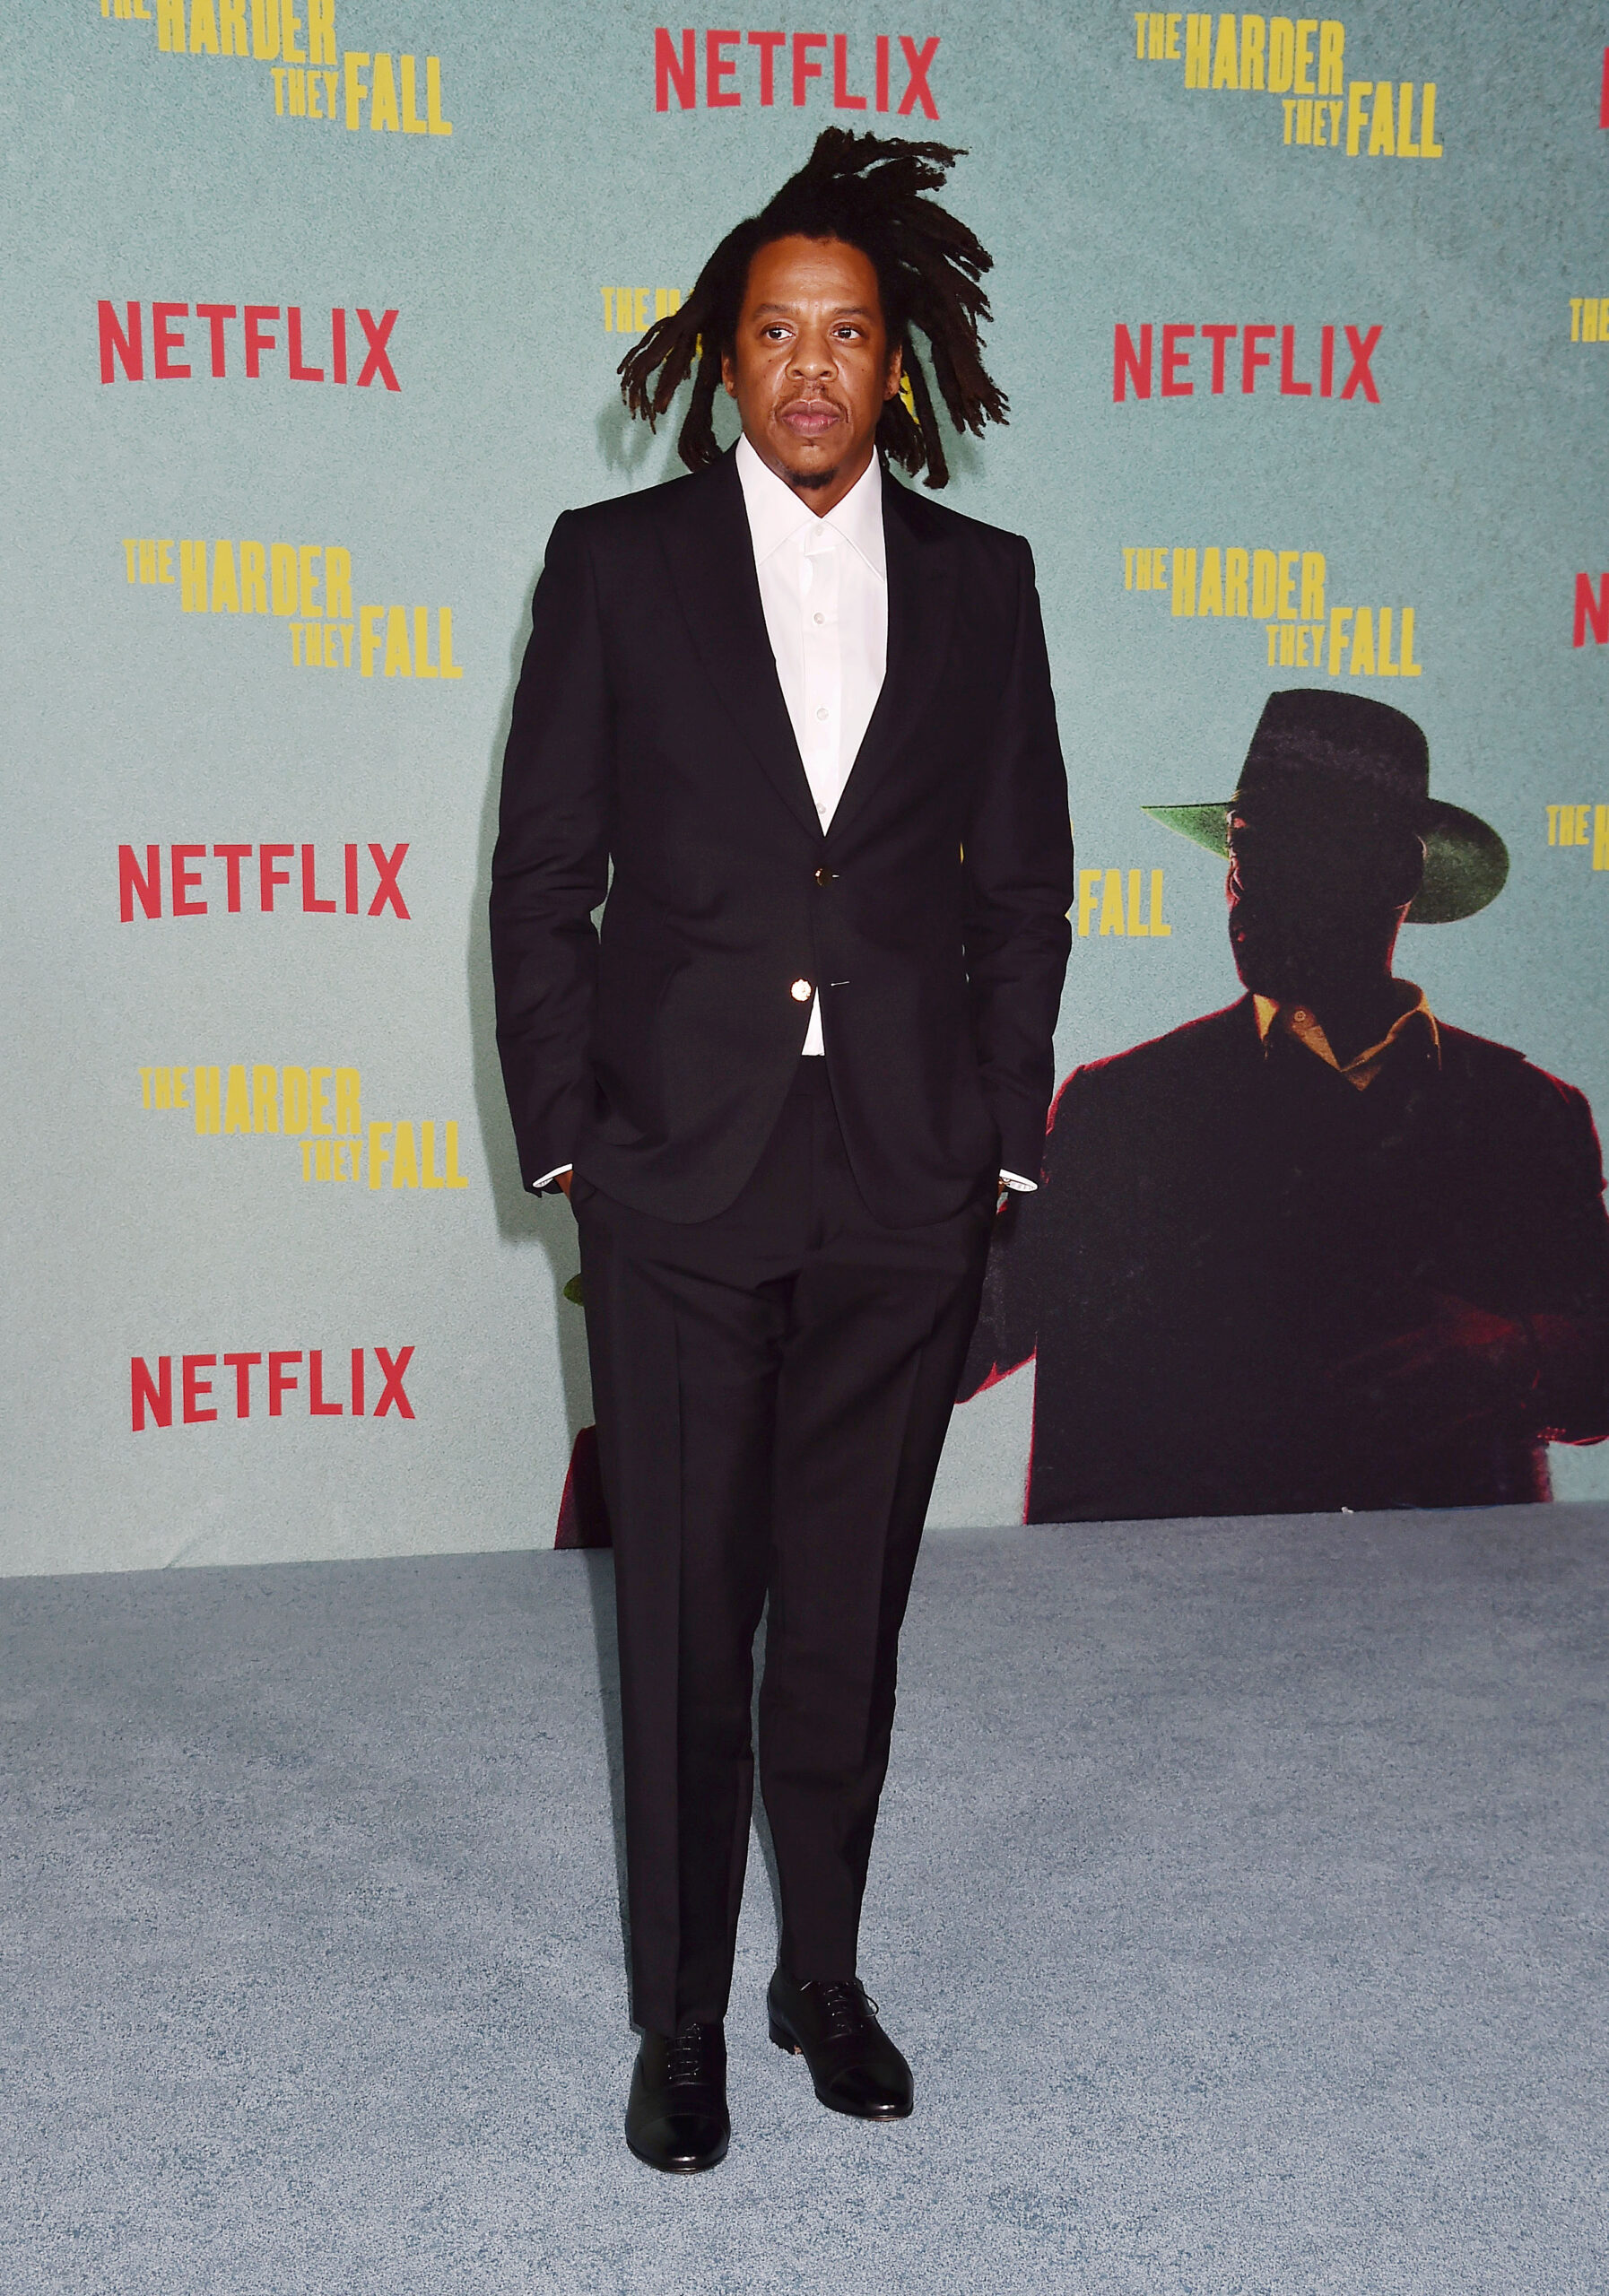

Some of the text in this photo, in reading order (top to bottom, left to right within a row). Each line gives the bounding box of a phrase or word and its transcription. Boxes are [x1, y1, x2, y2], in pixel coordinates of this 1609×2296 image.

[157, 0, 337, 65] HARDER
[1132, 13, 1345, 96] THE HARDER
[271, 51, 453, 135] THEY FALL
[656, 29, 940, 120] NETFLIX
[1283, 81, 1443, 159] THEY FALL
[98, 300, 401, 392] NETFLIX
[601, 287, 650, 333] THE
[1113, 324, 1383, 404] NETFLIX
[123, 540, 353, 619] THE HARDER
[1124, 547, 1326, 621] THE HARDER
[290, 605, 463, 679] THEY FALL
[1266, 607, 1422, 677] THEY FALL
[1546, 804, 1591, 847] THE
[118, 844, 411, 923] NETFLIX
[1077, 868, 1171, 937] FALL
[139, 1065, 362, 1135] THE HARDER
[300, 1121, 469, 1190] THEY FALL
[131, 1347, 415, 1432] NETFLIX
